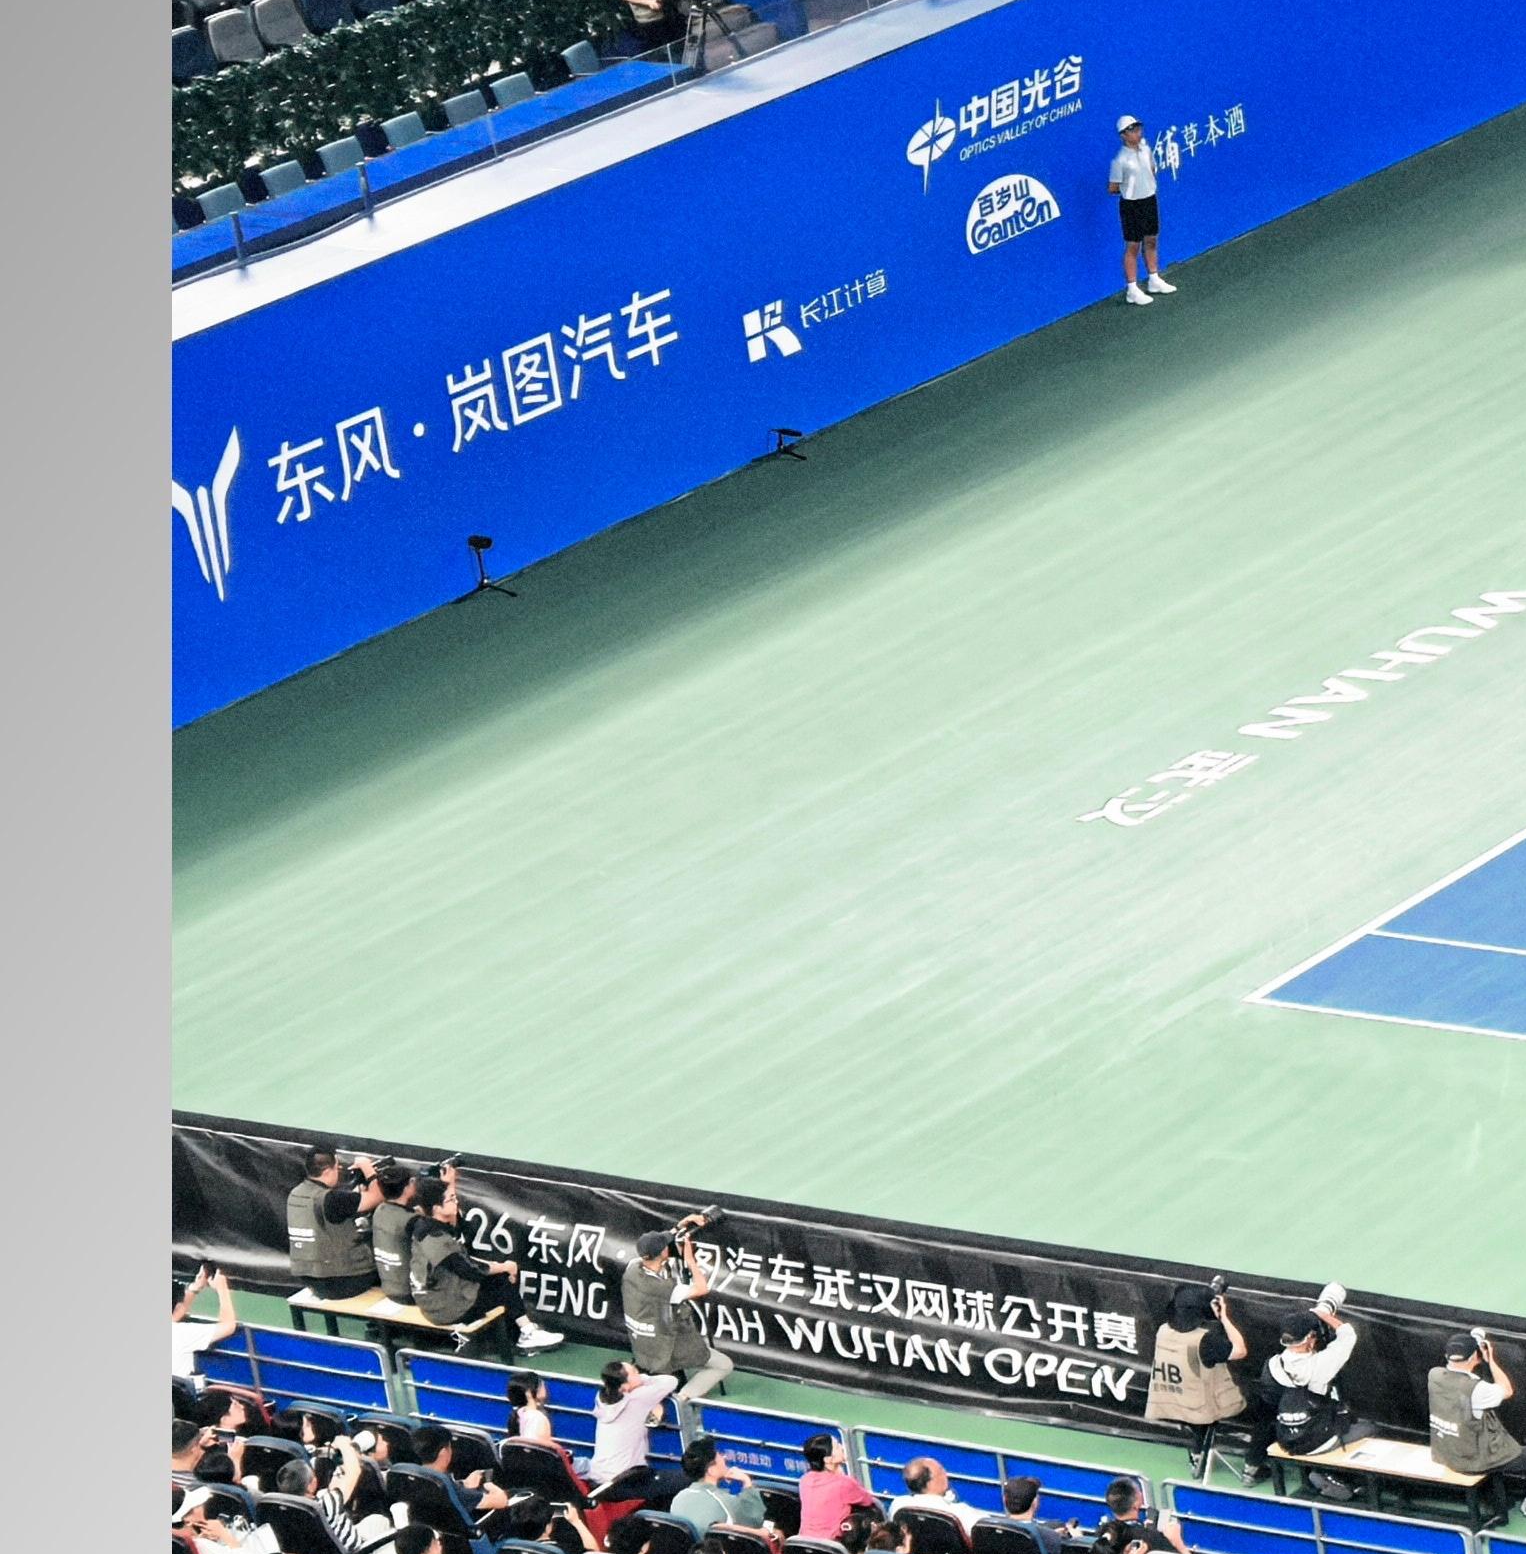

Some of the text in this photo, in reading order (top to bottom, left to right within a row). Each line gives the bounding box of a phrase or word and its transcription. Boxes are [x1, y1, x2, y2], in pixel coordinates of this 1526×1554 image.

[960, 55, 1083, 138] 中国光谷
[1049, 98, 1083, 123] CHINA
[976, 178, 1031, 218] 百岁山
[799, 268, 887, 328] 长江计算
[268, 288, 679, 525] 东风·岚图汽车
[1075, 749, 1260, 827] 武汉
[774, 1313, 1135, 1402] WUHAN OPEN
